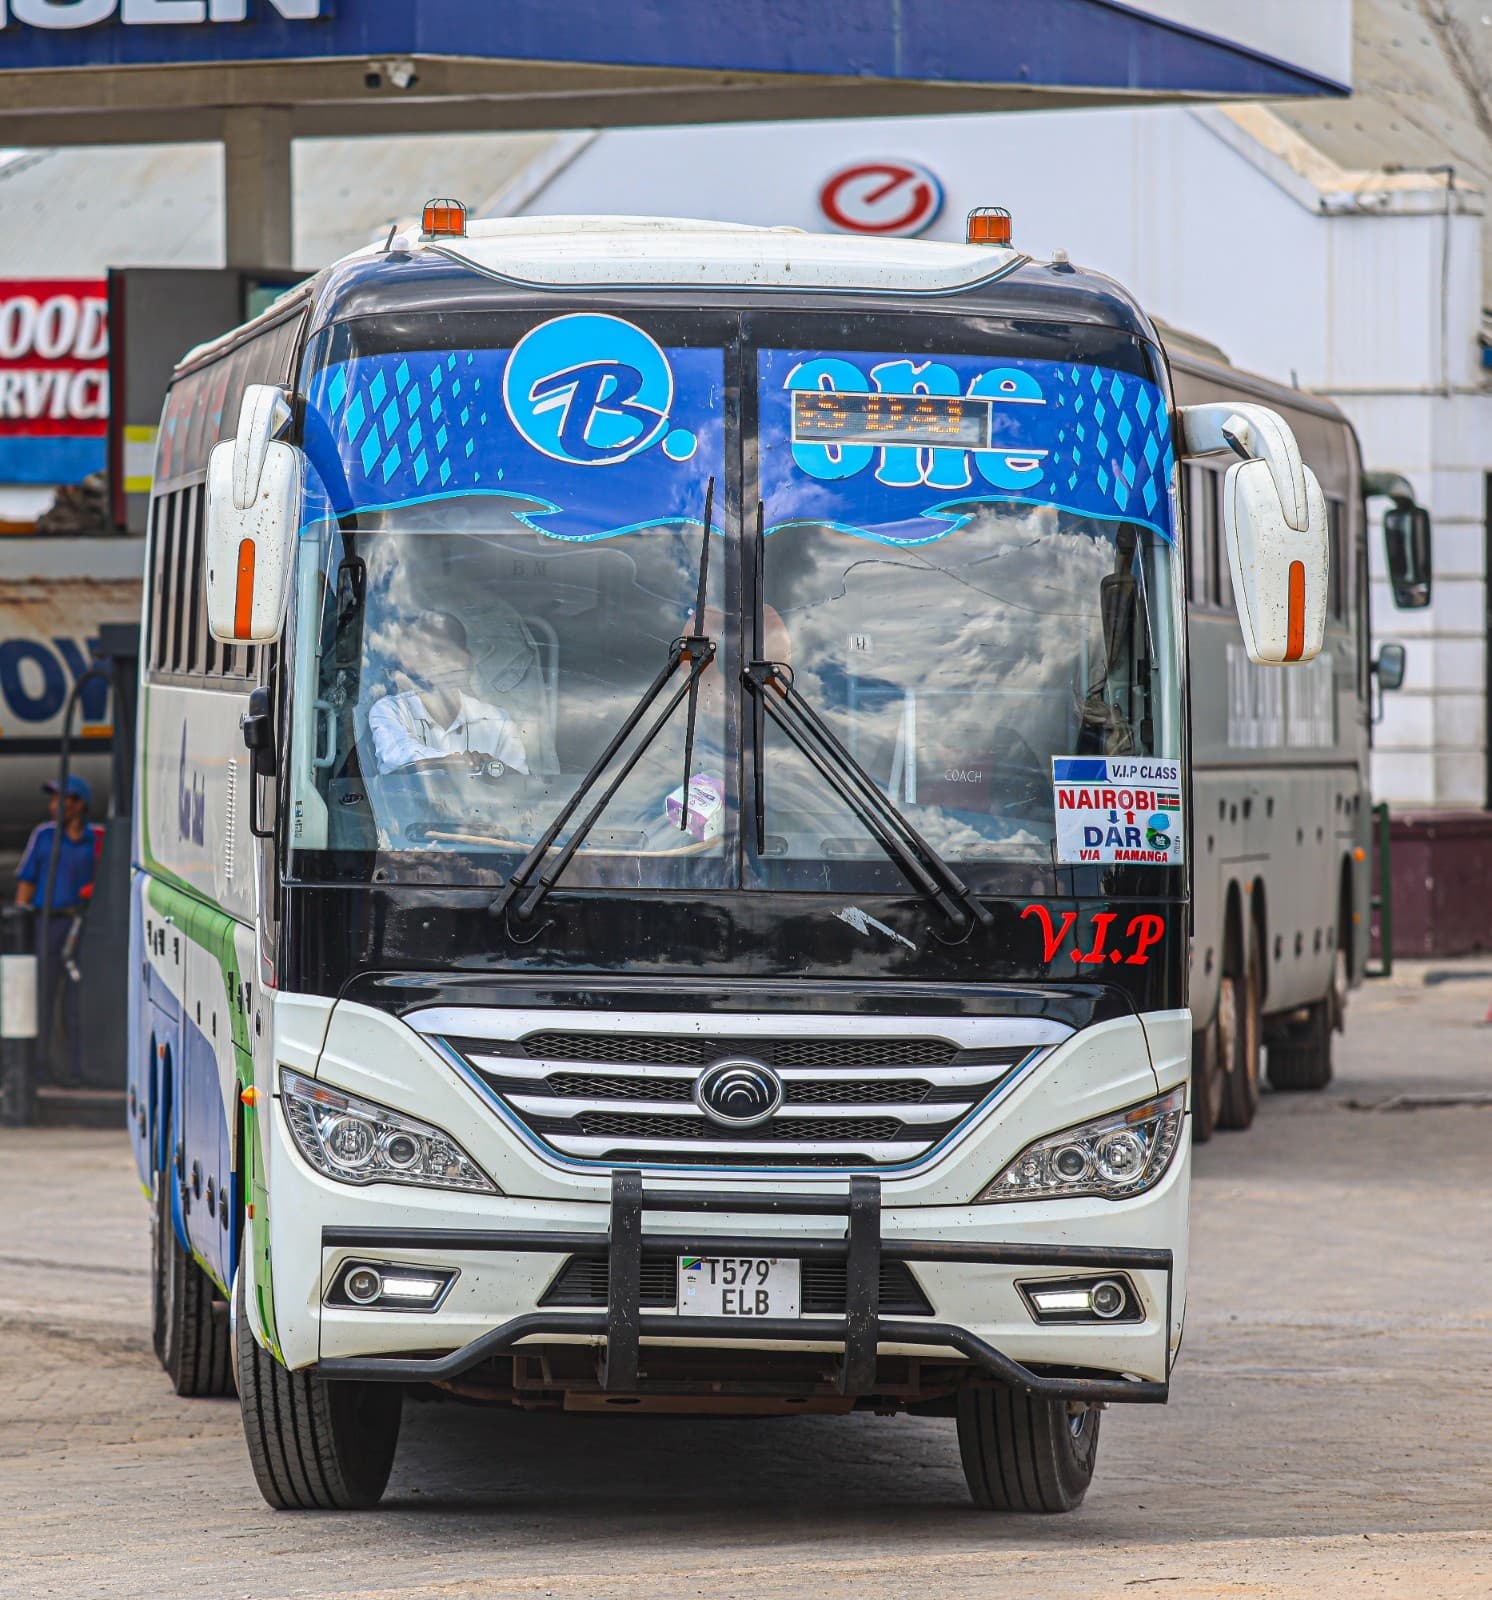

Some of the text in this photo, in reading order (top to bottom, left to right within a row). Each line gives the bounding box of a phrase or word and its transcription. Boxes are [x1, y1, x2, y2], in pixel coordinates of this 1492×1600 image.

[944, 768, 983, 783] COACH
[1111, 764, 1178, 780] V.I.P CLASS
[1058, 789, 1156, 811] NAIROBI
[1083, 826, 1142, 848] DAR
[1079, 849, 1169, 863] VIA NAMANGA
[1019, 903, 1166, 966] V.I.P
[707, 1258, 770, 1286] T579
[722, 1288, 770, 1316] ELB
